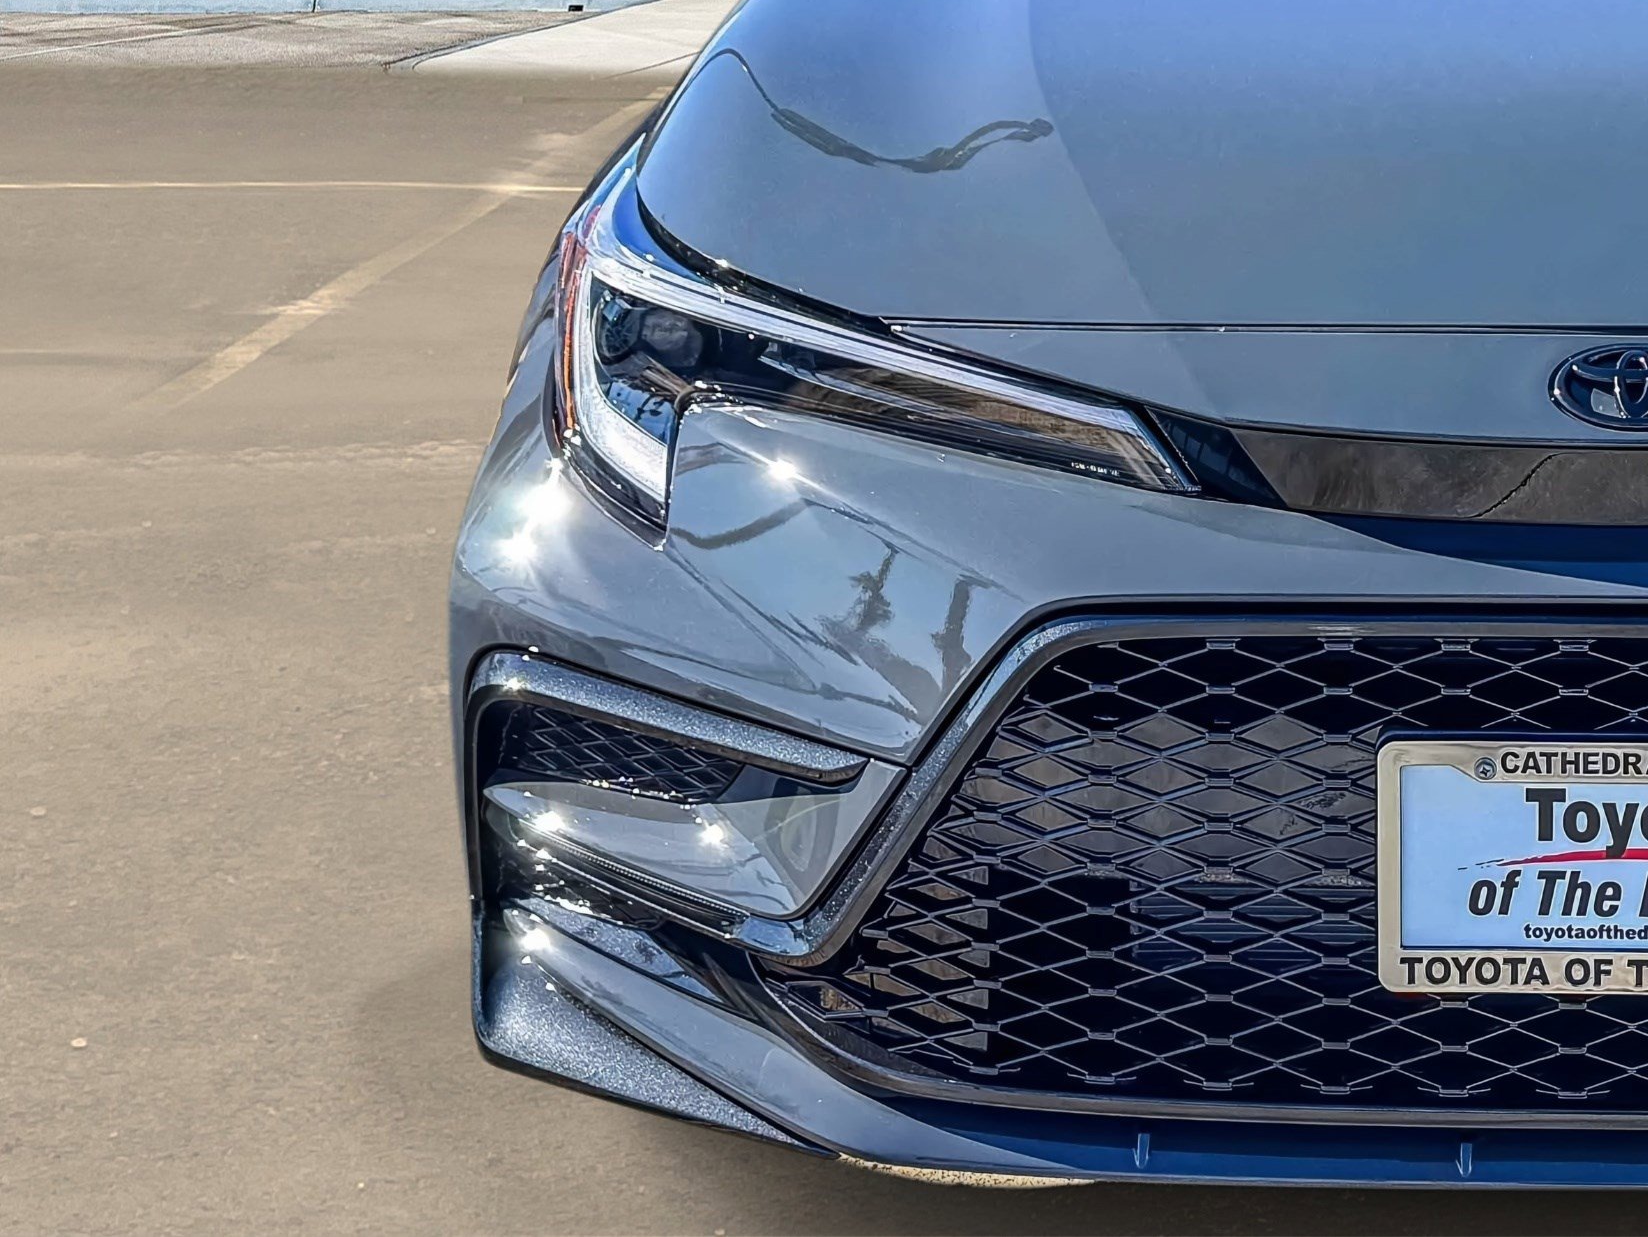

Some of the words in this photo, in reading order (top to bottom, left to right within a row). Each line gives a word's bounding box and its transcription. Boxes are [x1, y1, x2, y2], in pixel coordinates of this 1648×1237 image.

[1467, 869, 1520, 917] of
[1537, 870, 1623, 918] The
[1400, 956, 1548, 987] TOYOTA
[1564, 957, 1613, 988] OF
